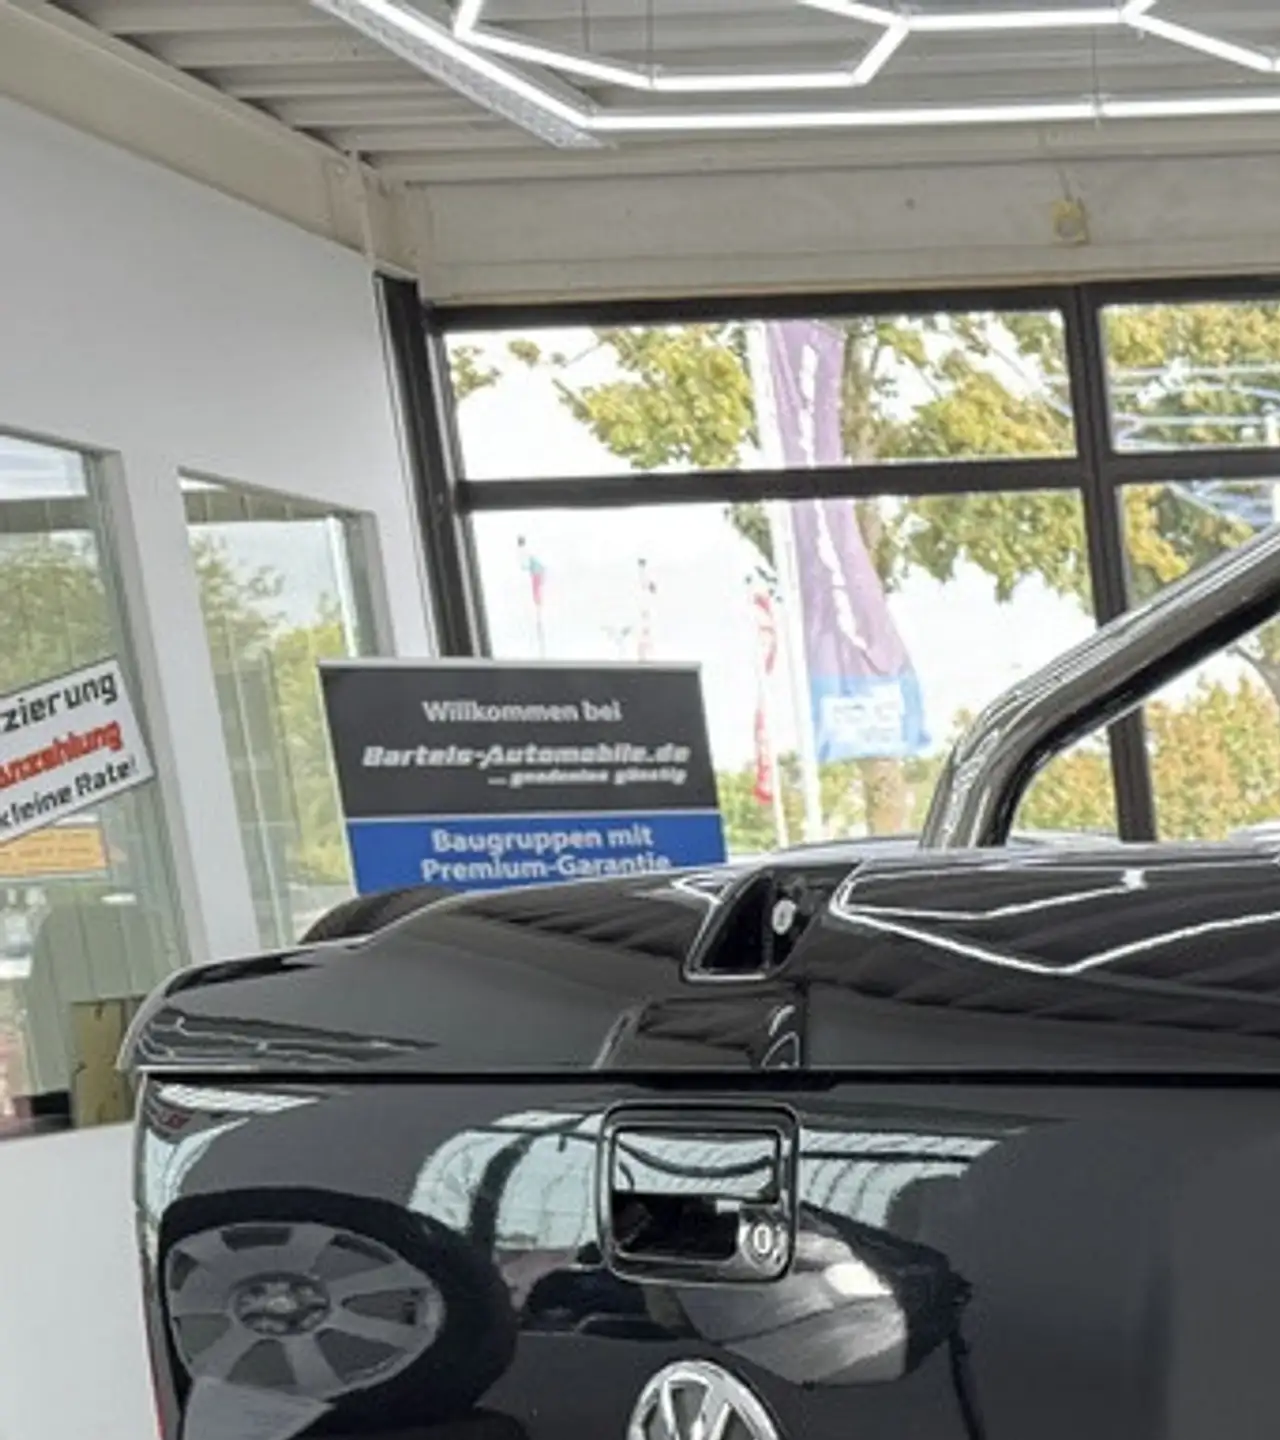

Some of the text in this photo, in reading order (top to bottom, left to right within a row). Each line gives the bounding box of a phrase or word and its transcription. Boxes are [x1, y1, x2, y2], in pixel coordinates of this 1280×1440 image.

[422, 700, 622, 722] Willkommen bei
[431, 823, 654, 855] Baugruppen mit
[421, 851, 671, 882] Premium-Garantie
